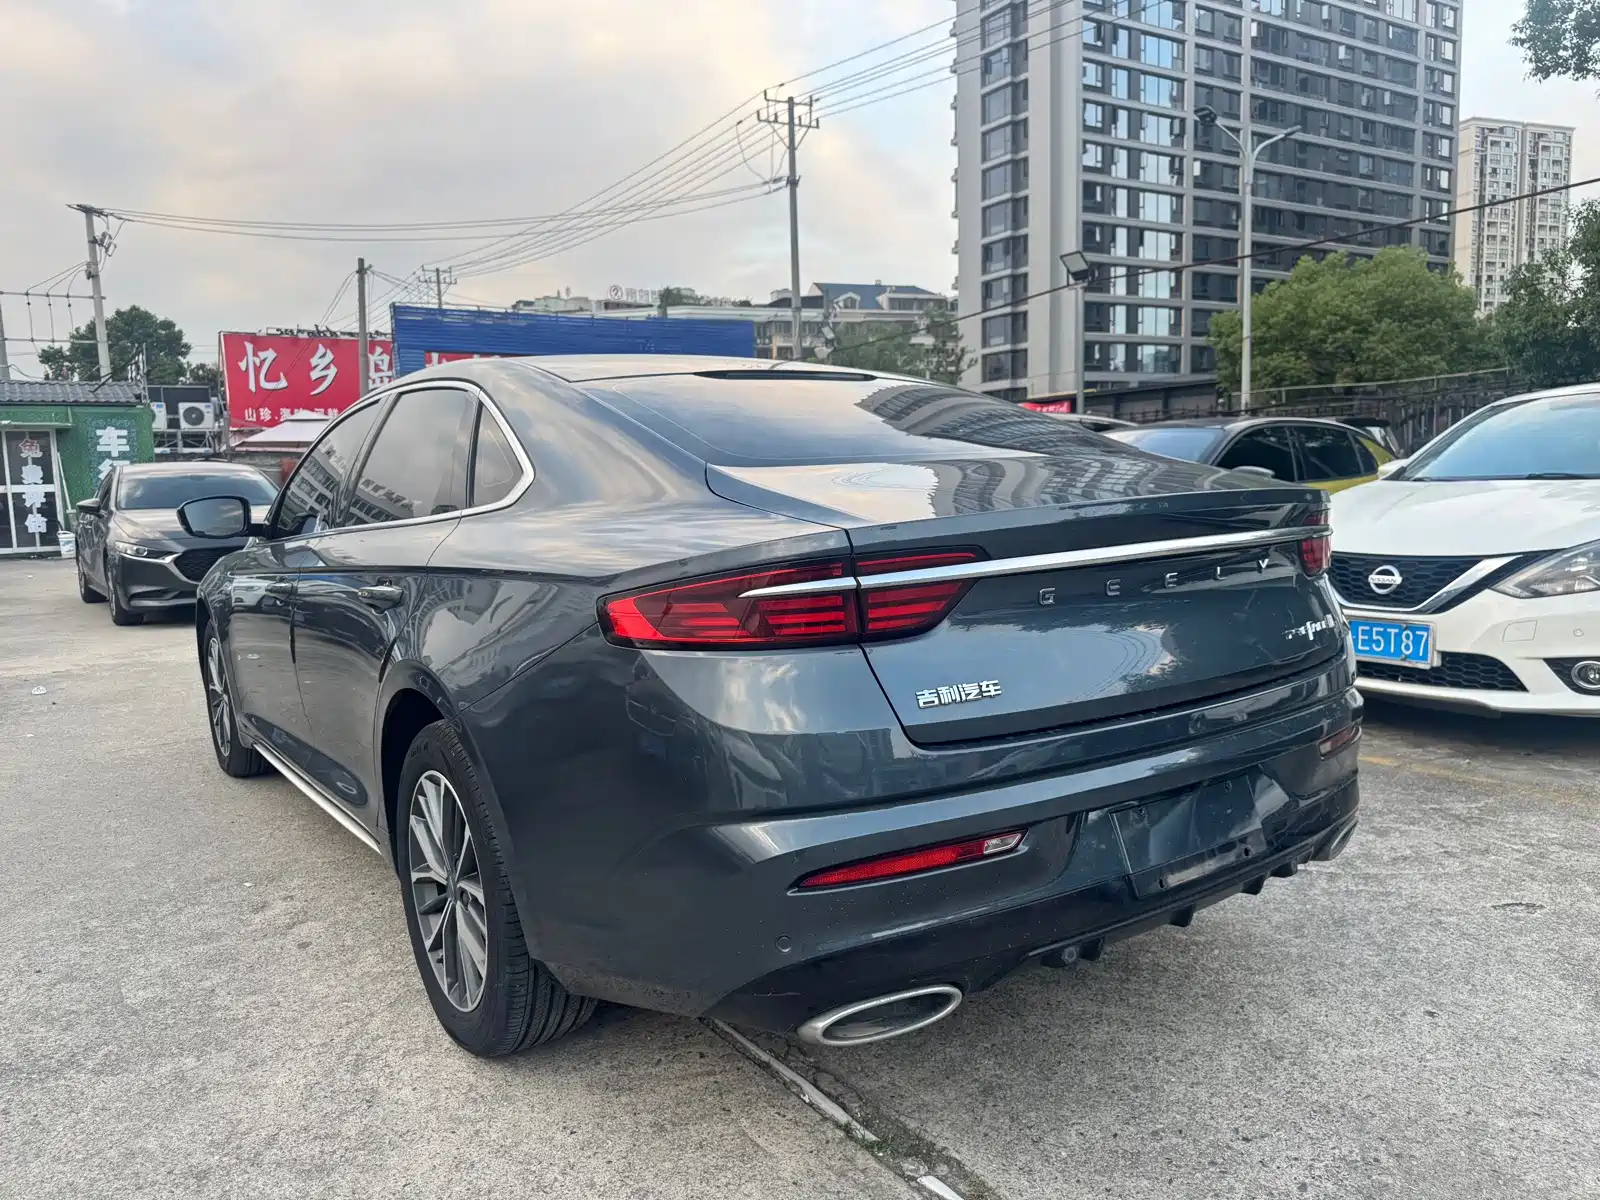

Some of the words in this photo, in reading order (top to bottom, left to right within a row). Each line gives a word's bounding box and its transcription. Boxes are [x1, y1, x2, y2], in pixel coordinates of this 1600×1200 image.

[1370, 576, 1398, 584] NISSAN
[915, 679, 1003, 709] 吉利汽车
